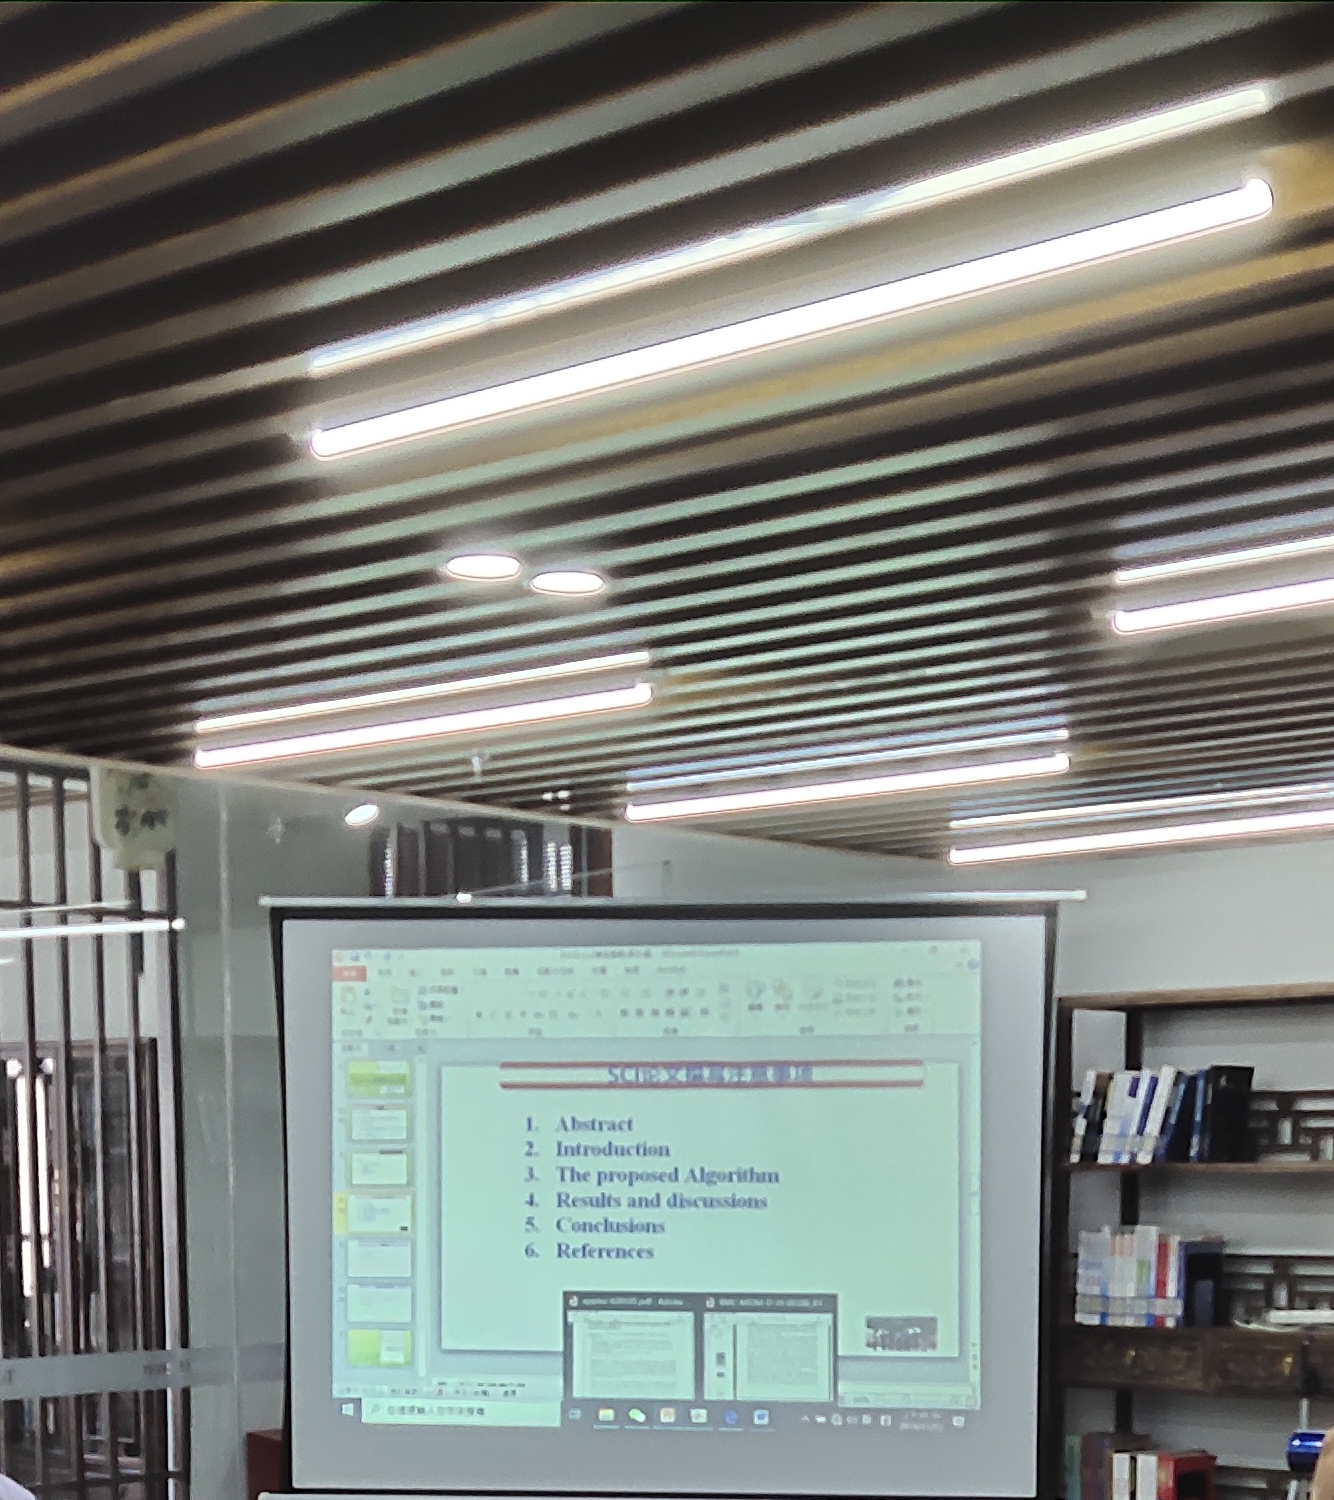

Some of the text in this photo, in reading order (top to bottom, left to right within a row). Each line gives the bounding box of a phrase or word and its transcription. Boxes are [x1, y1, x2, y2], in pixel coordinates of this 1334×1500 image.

[556, 1116, 634, 1133] Abstract
[524, 1141, 671, 1158] 2. Introduction
[556, 1166, 591, 1183] The
[596, 1167, 679, 1187] proposed
[685, 1166, 780, 1186] Algorithm
[556, 1192, 621, 1208] Results
[627, 1193, 661, 1208] and
[667, 1193, 768, 1209] discussions
[556, 1217, 665, 1234] Conclusions
[556, 1242, 654, 1259] References
